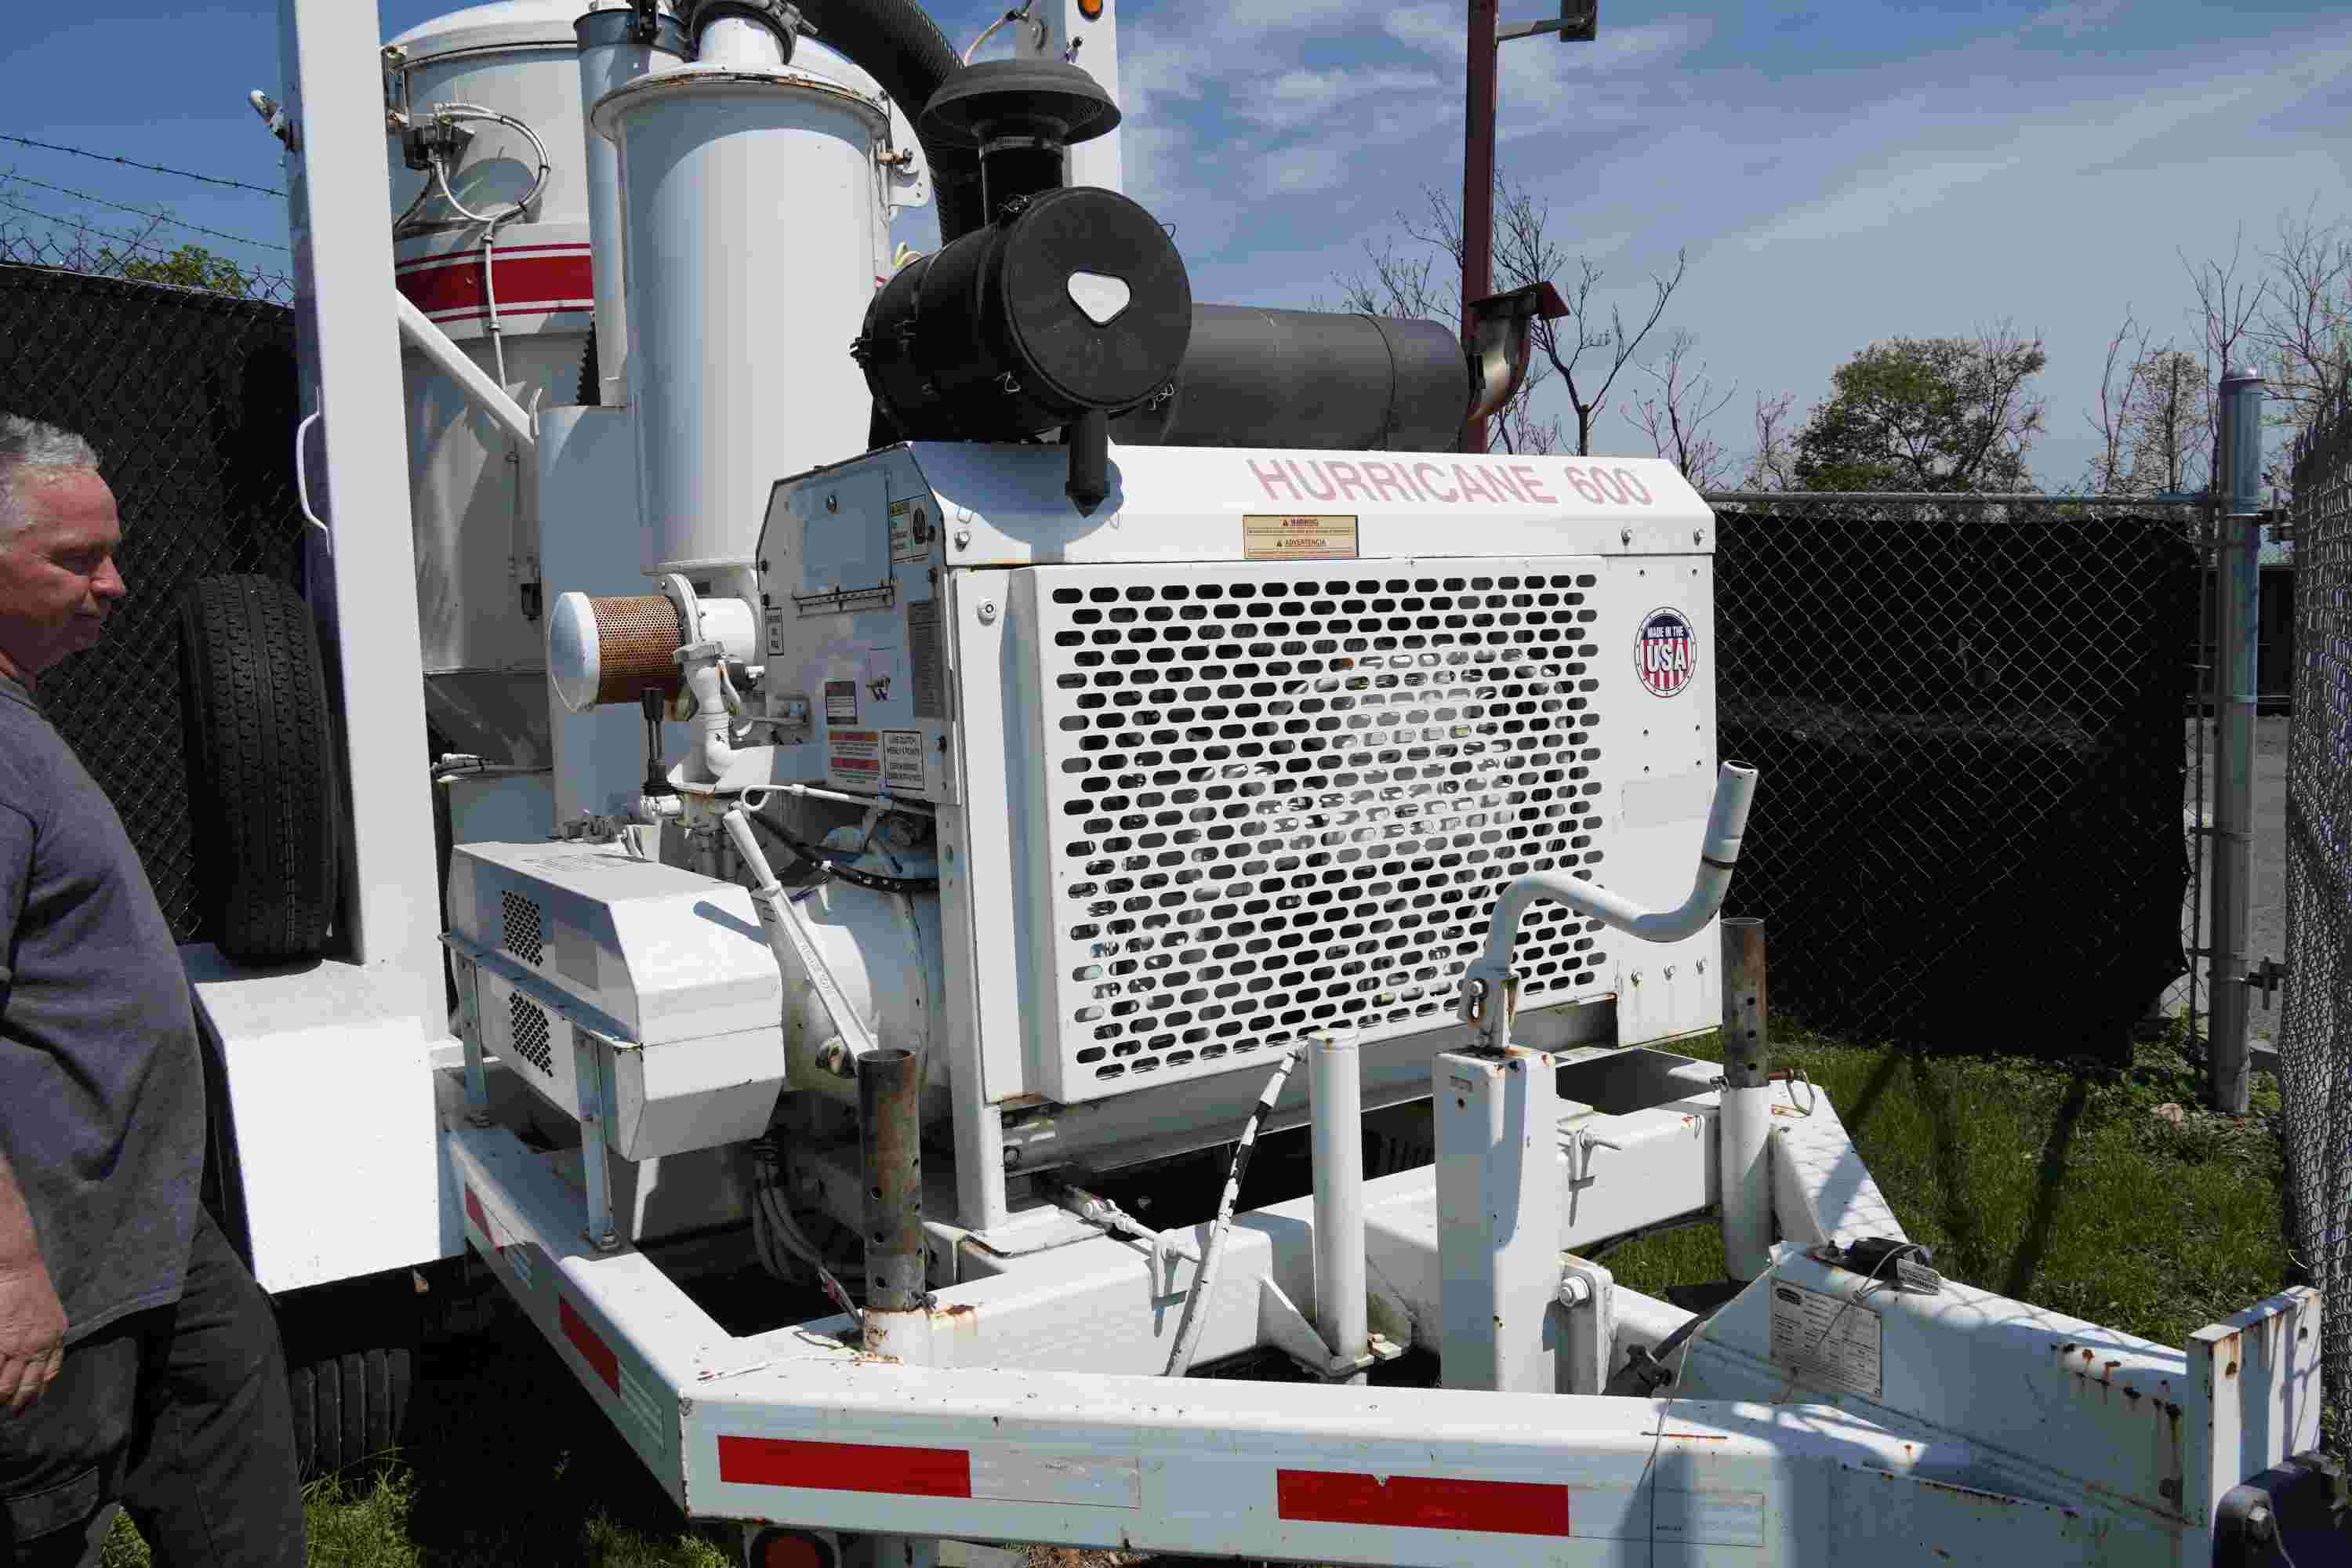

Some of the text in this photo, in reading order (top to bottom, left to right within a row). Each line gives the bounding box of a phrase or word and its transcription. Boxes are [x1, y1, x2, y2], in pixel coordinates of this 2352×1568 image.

[1245, 457, 1653, 504] HURRICANE 600
[1647, 626, 1684, 638] MADE IN THE
[1646, 644, 1687, 673] USA
